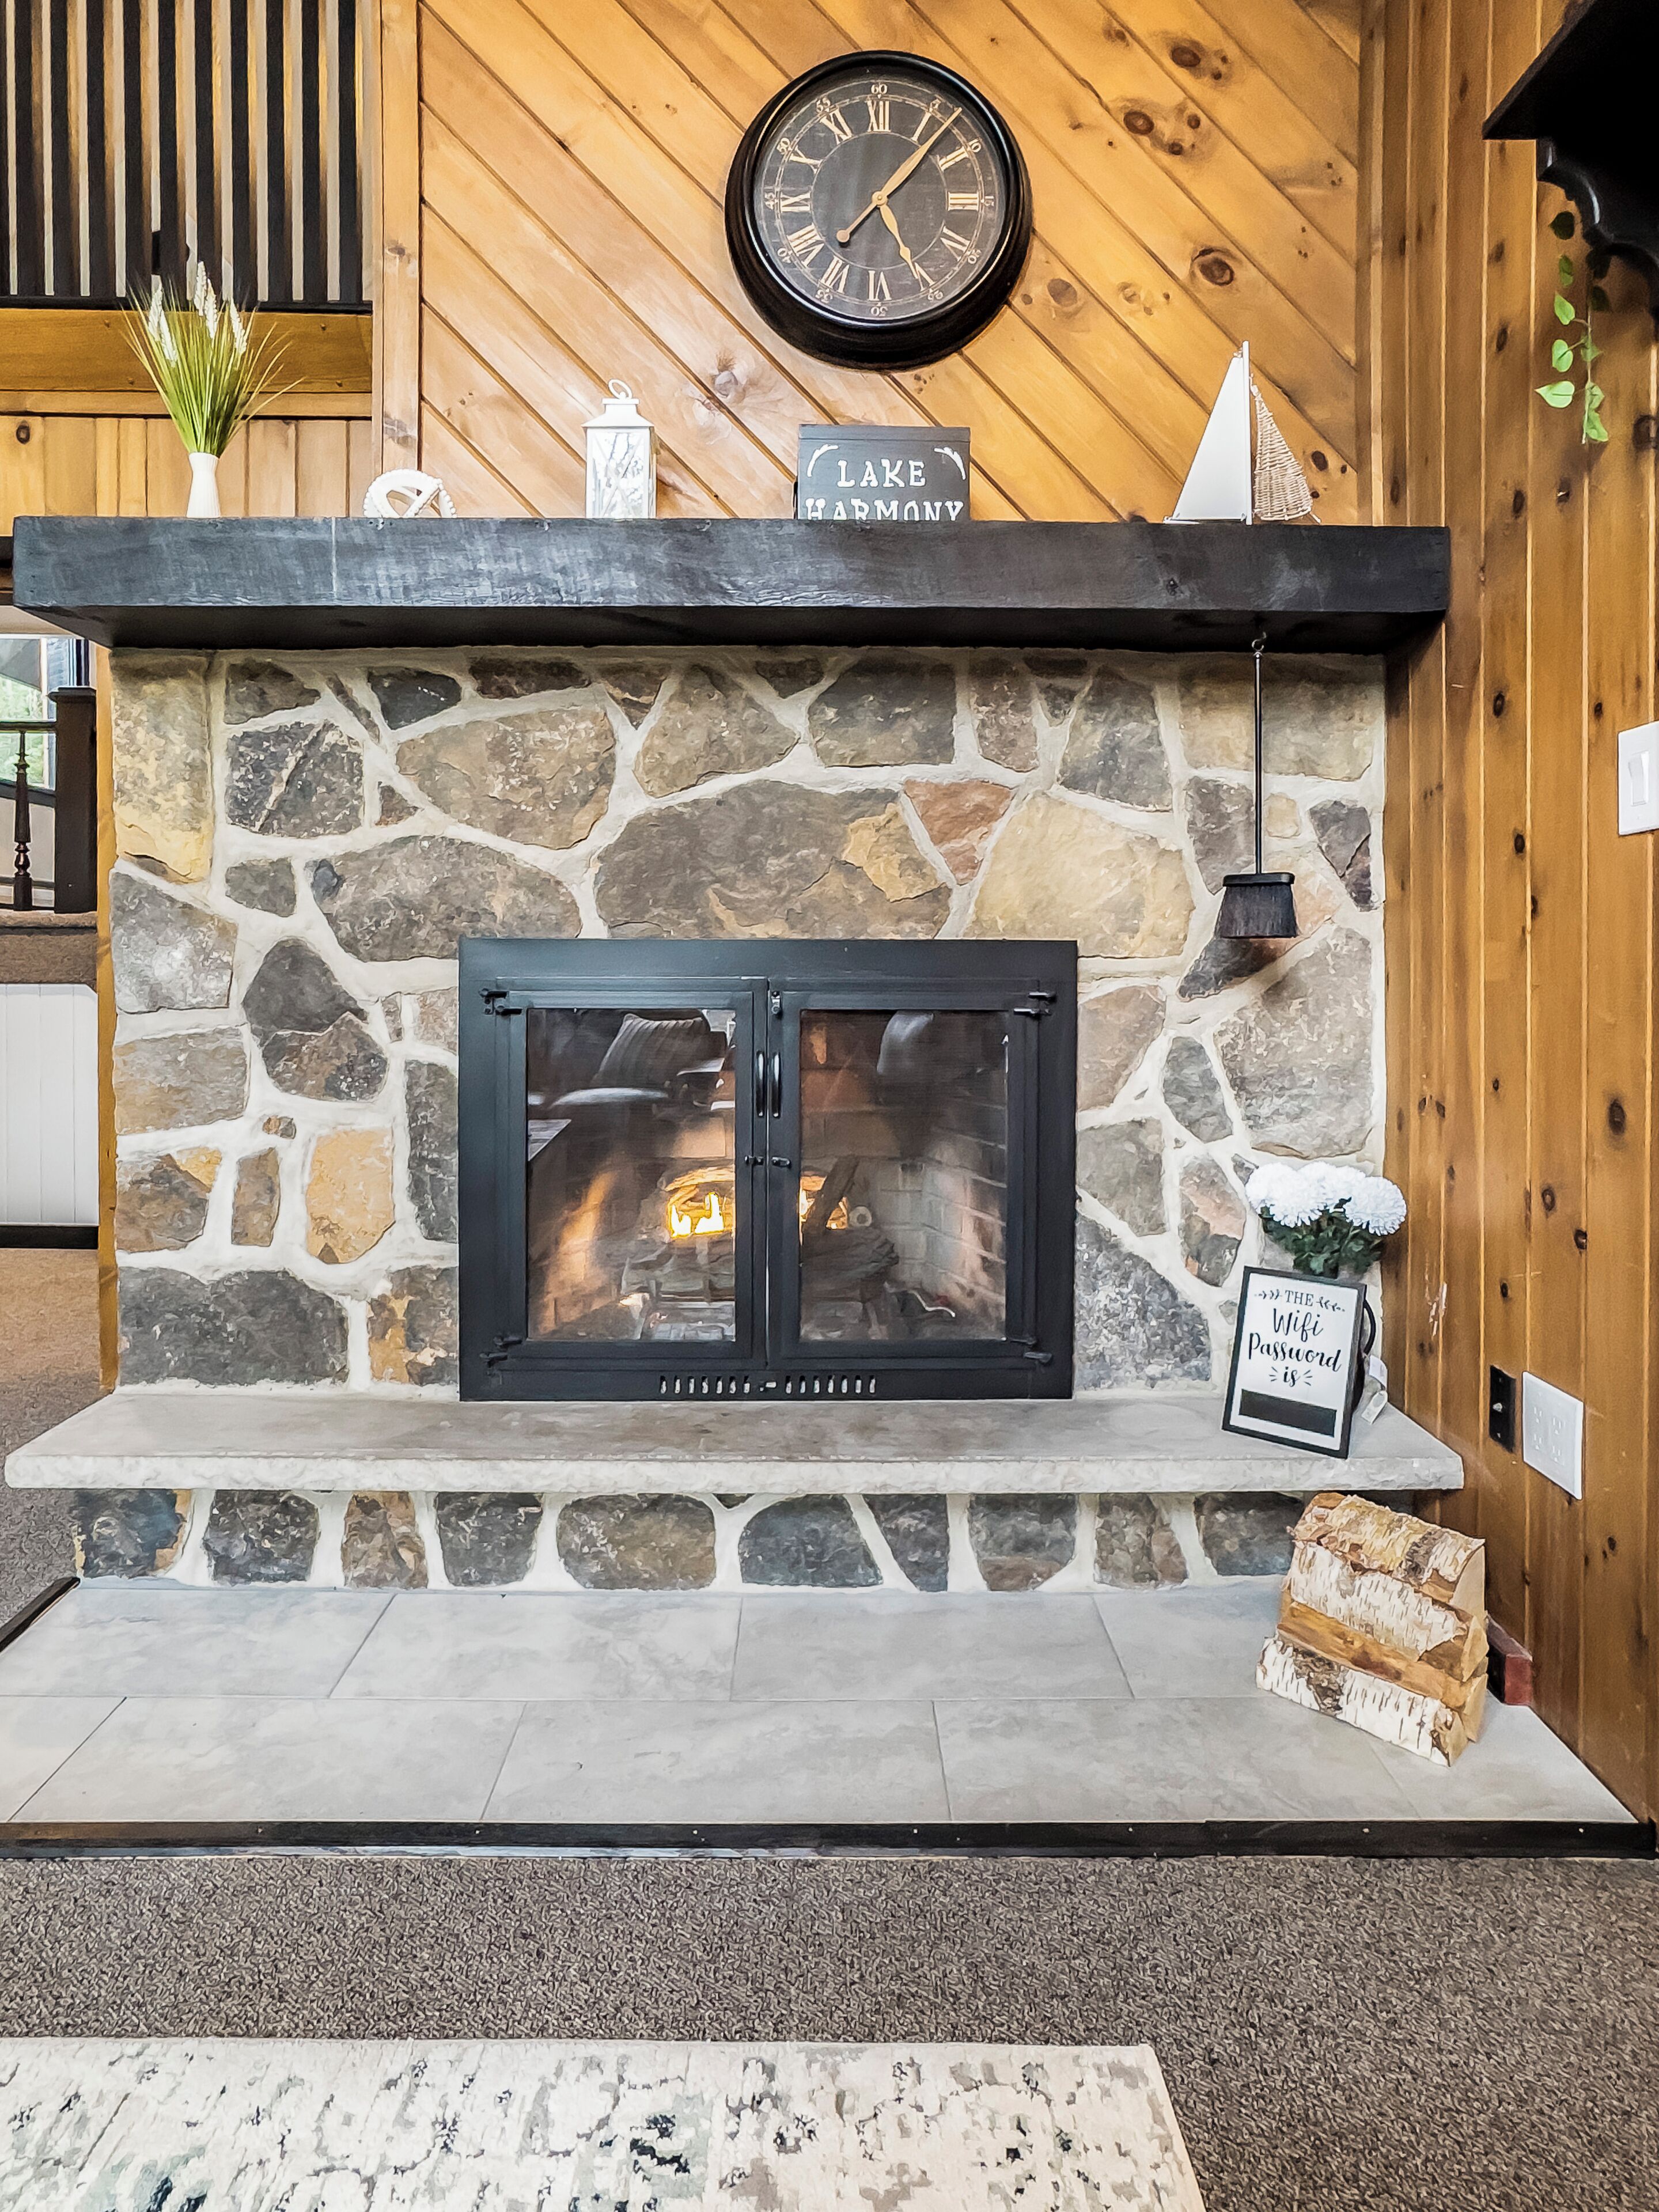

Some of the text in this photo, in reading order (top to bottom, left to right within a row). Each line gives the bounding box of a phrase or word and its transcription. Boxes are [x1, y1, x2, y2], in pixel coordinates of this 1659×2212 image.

[871, 84, 888, 94] 60
[819, 105, 853, 144] XI
[866, 100, 891, 132] XII
[911, 111, 932, 142] I
[777, 137, 790, 154] 50
[937, 145, 969, 172] II
[969, 138, 982, 153] 10
[789, 145, 824, 174] X
[764, 192, 775, 210] 45
[781, 191, 811, 214] IX
[948, 191, 979, 211] III
[984, 195, 995, 207] 15
[777, 248, 791, 263] 40
[787, 222, 825, 268] VIII
[940, 225, 971, 262] IV
[818, 255, 850, 294] VII
[868, 270, 892, 301] VI
[914, 262, 938, 292] V
[870, 306, 888, 317] 30
[837, 459, 926, 488] LAKE
[805, 498, 964, 521] HARMONY
[1284, 1290, 1314, 1307] THE
[1272, 1308, 1323, 1342] Wifi
[1248, 1332, 1342, 1372] Password
[1283, 1366, 1301, 1387] is
